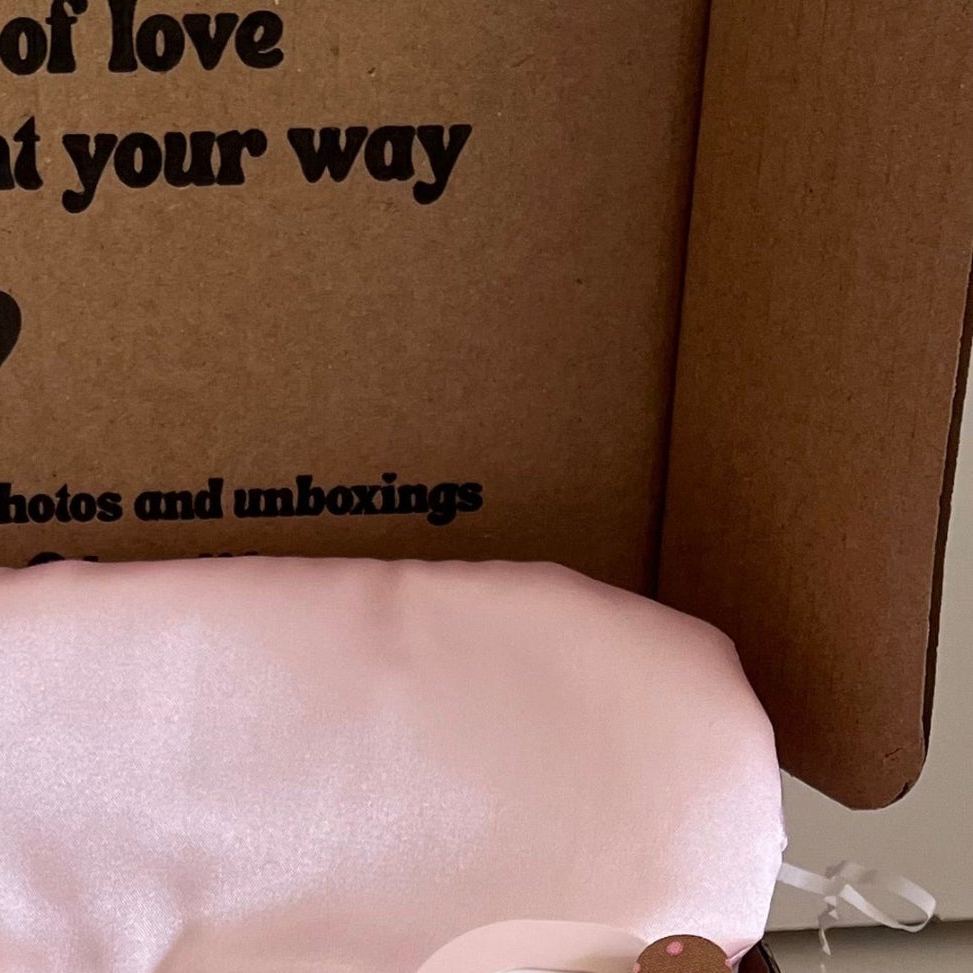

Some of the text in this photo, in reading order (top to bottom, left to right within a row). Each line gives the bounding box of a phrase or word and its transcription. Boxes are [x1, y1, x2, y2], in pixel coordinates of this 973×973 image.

[108, 0, 283, 72] love
[62, 129, 267, 213] your
[287, 124, 472, 204] way
[134, 478, 223, 521] and
[234, 473, 483, 526] unboxings
